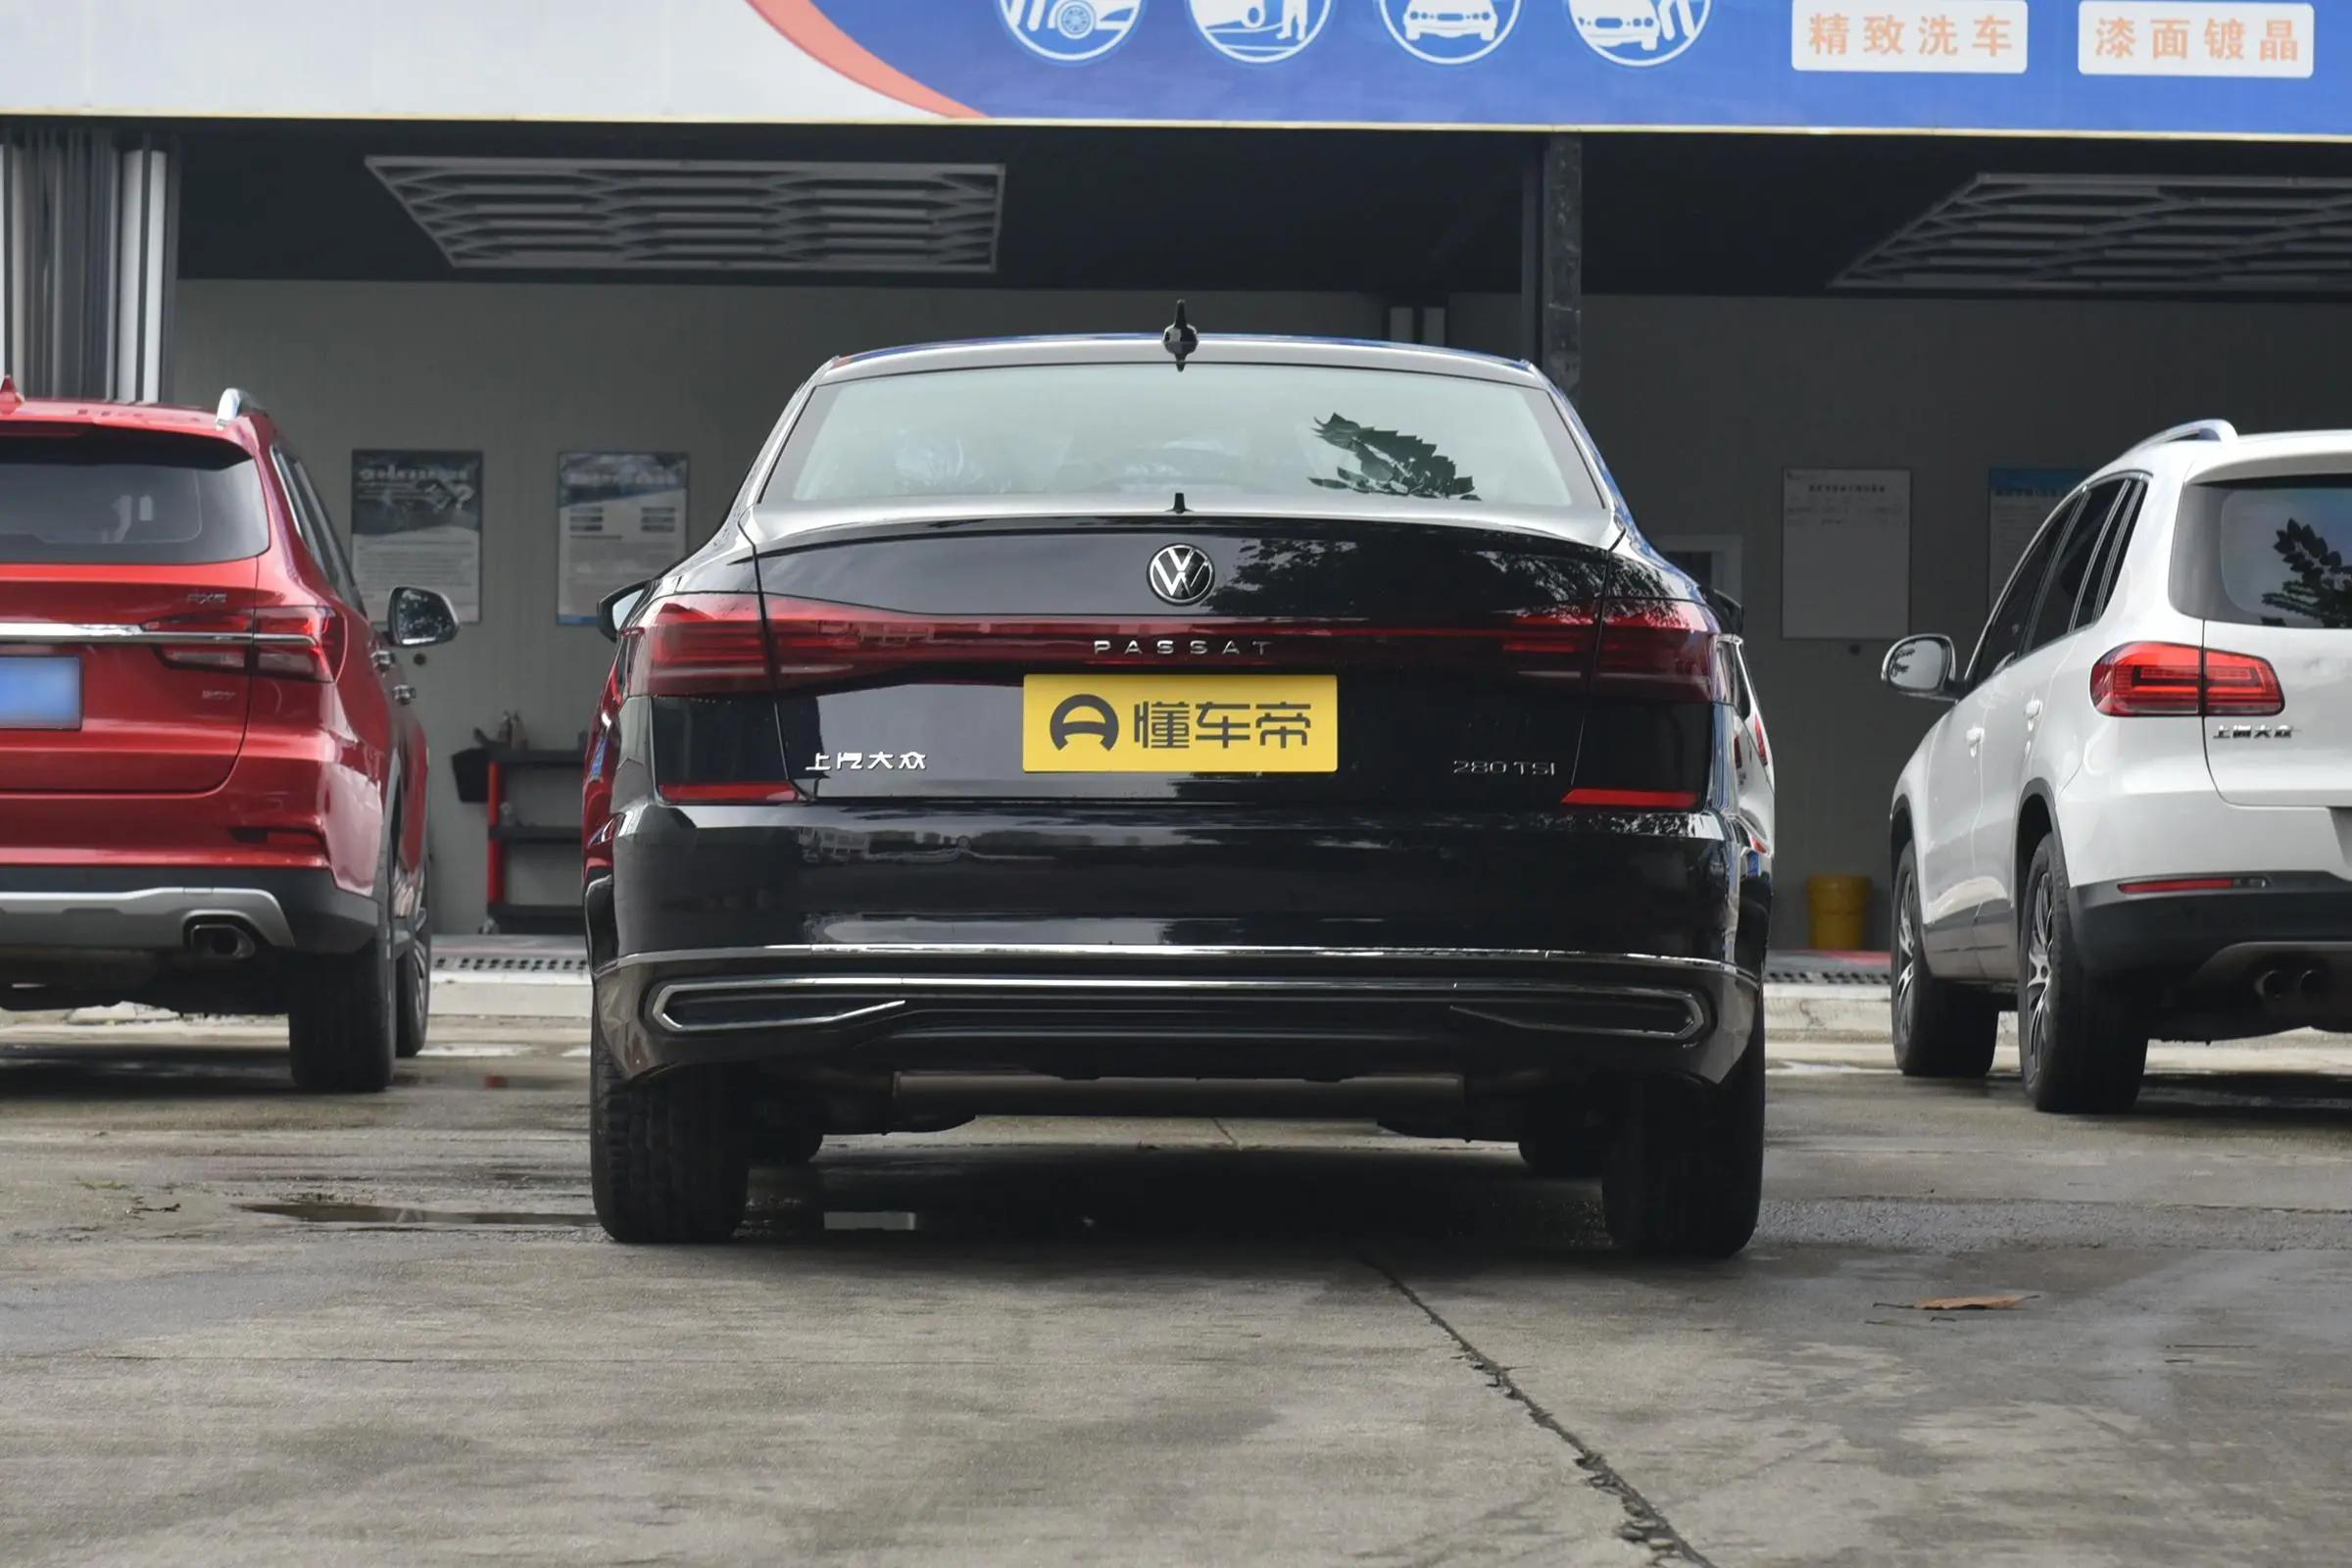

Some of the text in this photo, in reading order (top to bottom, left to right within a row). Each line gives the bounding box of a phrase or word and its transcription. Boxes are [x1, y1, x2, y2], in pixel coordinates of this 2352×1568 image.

[1809, 13, 2012, 57] 精致洗车
[2095, 17, 2298, 61] 漆面镀晶
[1094, 640, 1272, 655] PASSAT
[1134, 701, 1311, 749] 懂车帝
[805, 751, 926, 771] 上汽大众
[1452, 760, 1555, 776] 280 TSI
